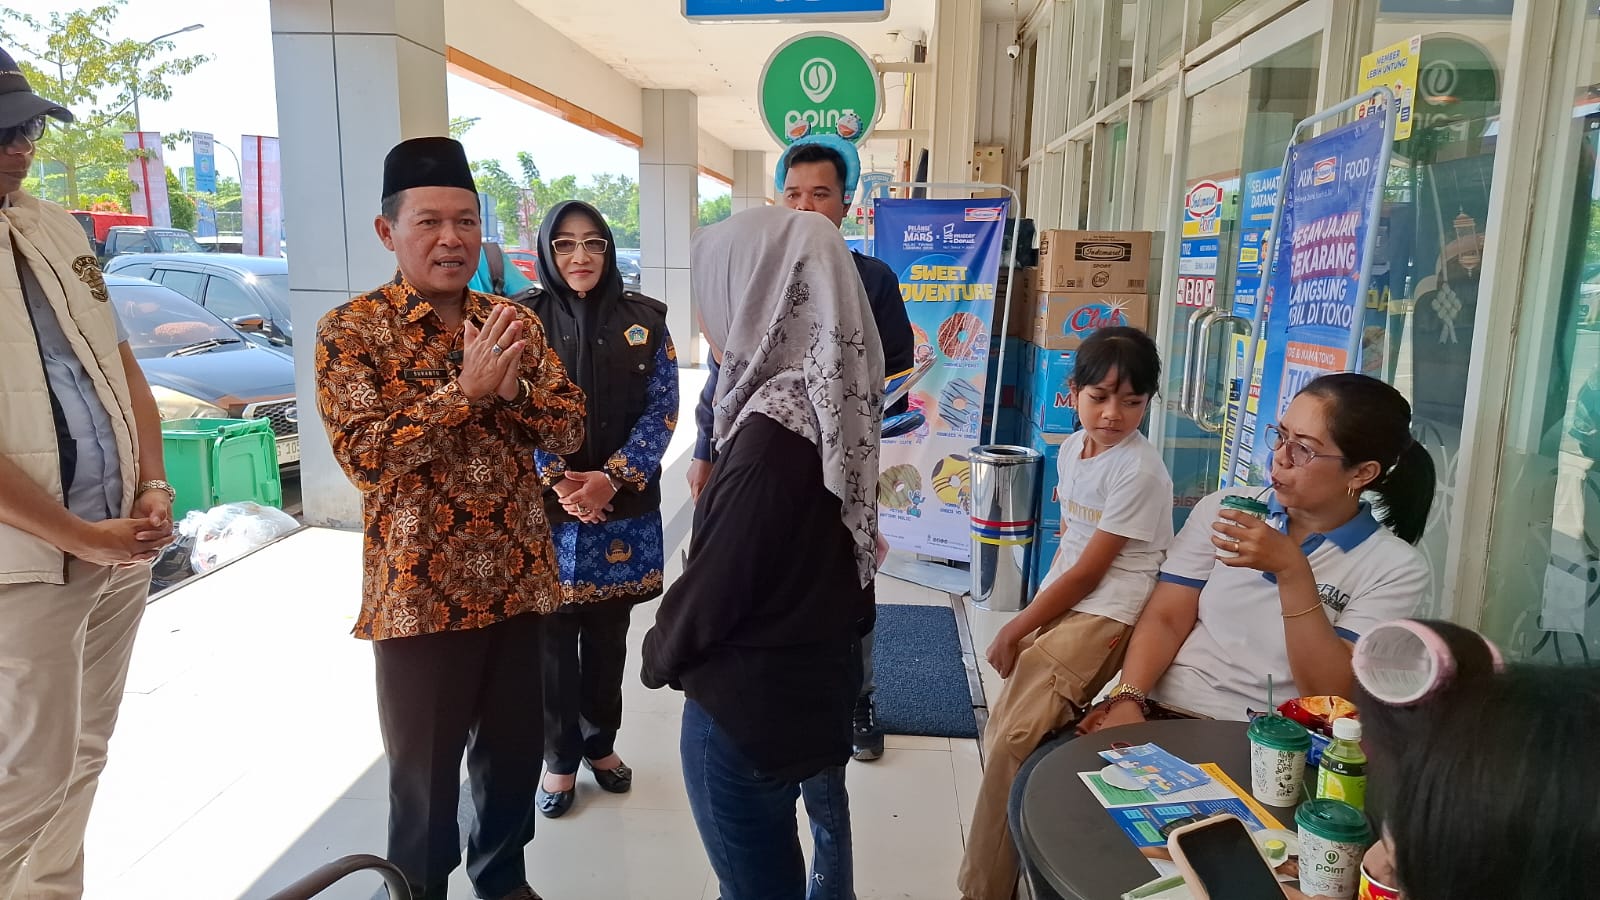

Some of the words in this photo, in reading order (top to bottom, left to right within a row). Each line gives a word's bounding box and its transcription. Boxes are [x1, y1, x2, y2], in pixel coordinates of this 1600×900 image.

[1376, 50, 1400, 64] MEMBER
[1367, 68, 1383, 79] LEBIH
[1344, 157, 1369, 181] FOOD
[1322, 214, 1359, 238] JAJAN
[904, 231, 933, 242] MARS
[1085, 247, 1121, 256] Indomaret
[910, 265, 968, 281] SWEET
[899, 284, 993, 302] DVENTURE
[1307, 302, 1320, 325] DI
[1315, 864, 1345, 874] POINT
